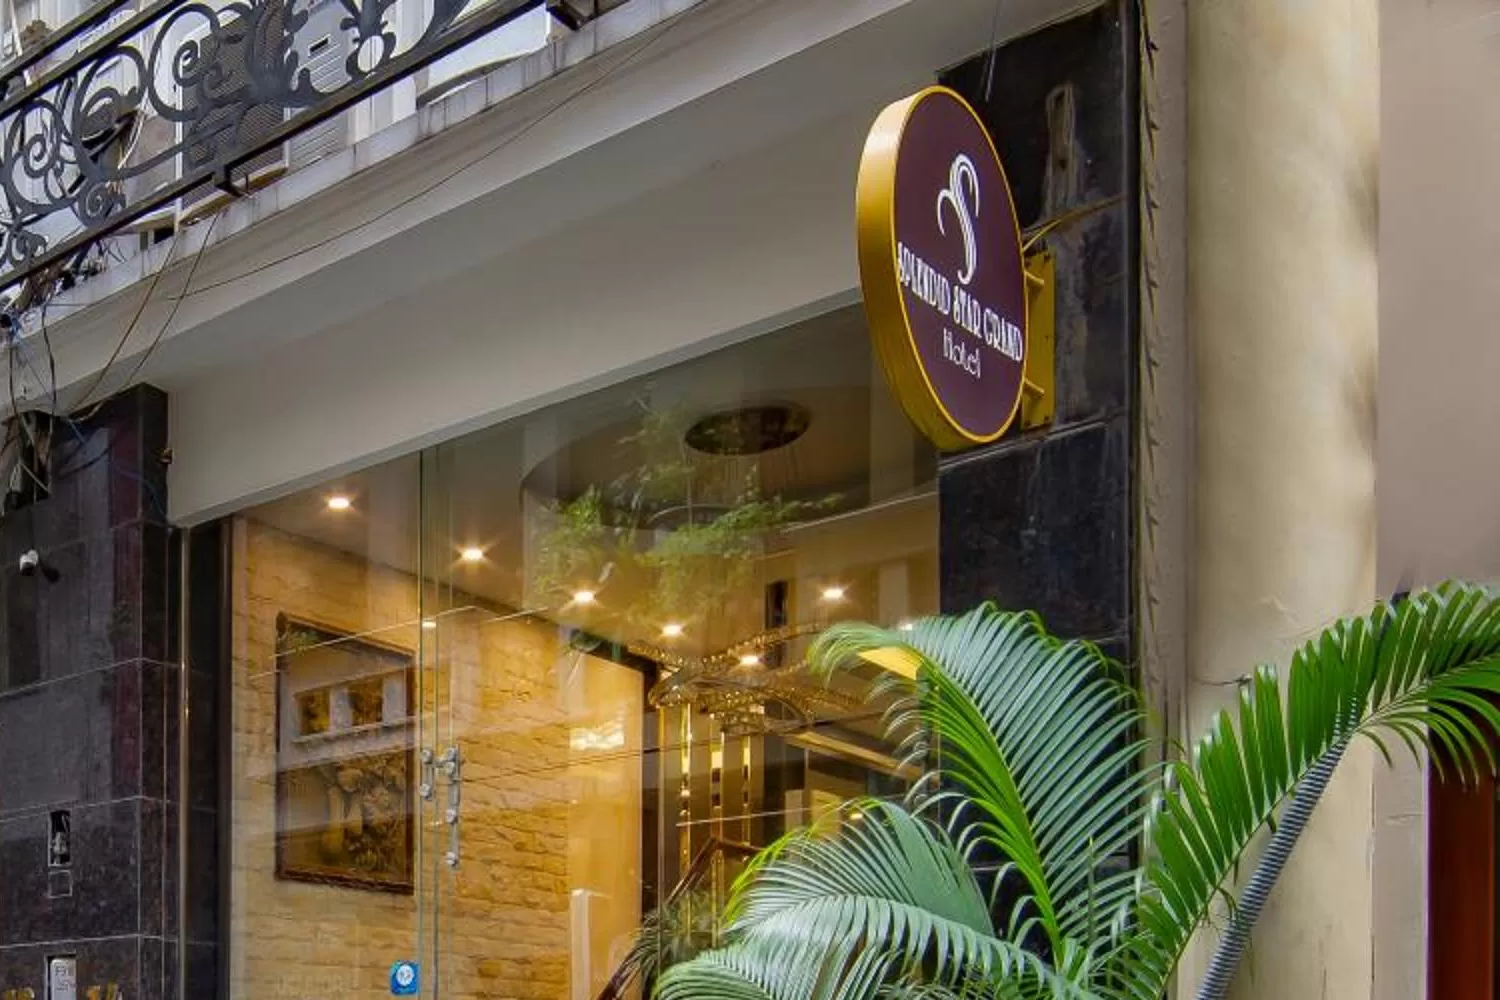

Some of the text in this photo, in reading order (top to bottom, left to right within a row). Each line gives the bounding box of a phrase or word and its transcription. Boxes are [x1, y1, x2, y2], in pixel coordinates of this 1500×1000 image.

[897, 241, 1023, 363] SPLENDID STAR GRAND
[943, 326, 981, 380] Hotel
